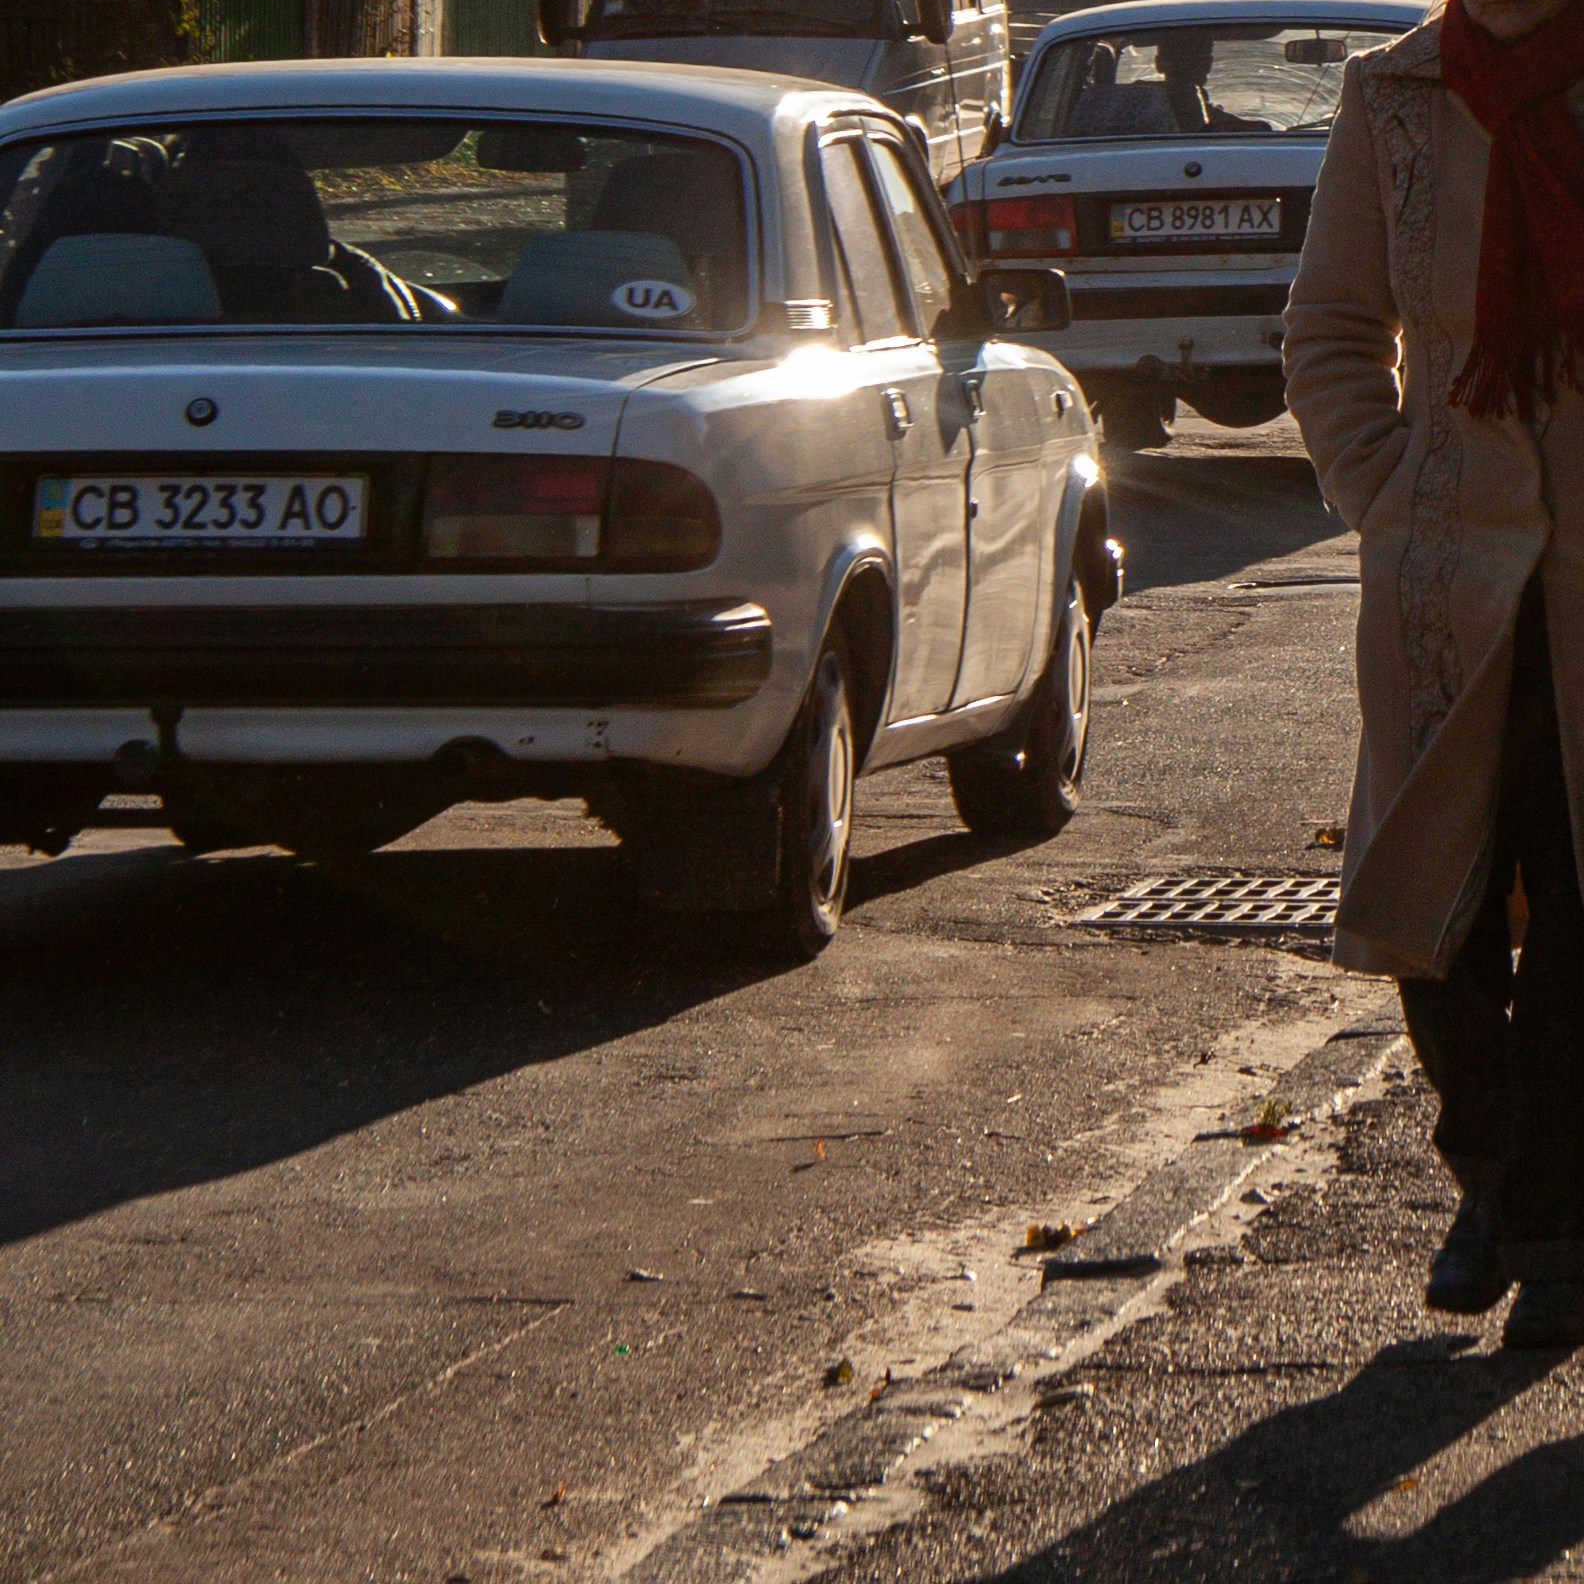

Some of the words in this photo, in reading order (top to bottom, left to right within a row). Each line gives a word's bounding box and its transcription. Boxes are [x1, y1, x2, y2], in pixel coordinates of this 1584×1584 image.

[1128, 207, 1164, 232] CB
[1171, 206, 1230, 231] 8981
[1237, 204, 1274, 230] AX
[625, 287, 678, 311] UA
[70, 485, 140, 531] CB
[155, 485, 266, 530] 3233
[277, 485, 349, 531] AO
